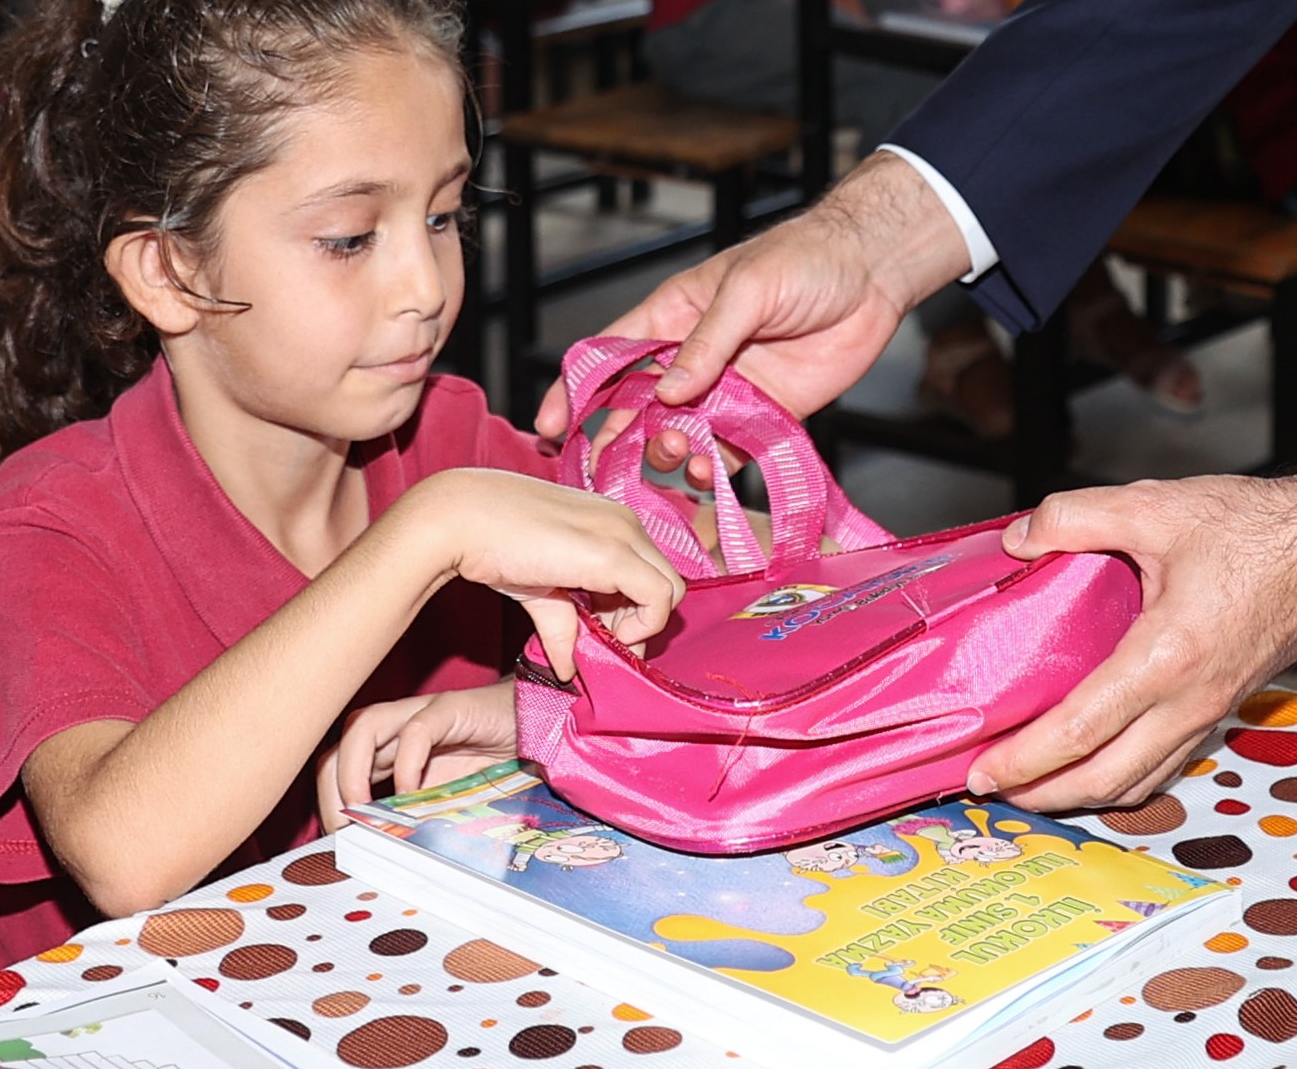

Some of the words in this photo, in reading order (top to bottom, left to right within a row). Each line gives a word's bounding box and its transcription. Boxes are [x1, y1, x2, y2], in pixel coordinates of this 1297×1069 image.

[1013, 852, 1080, 877] İLK
[861, 868, 970, 919] KİTABI
[914, 871, 1026, 922] OKUMA
[1004, 893, 1040, 907] 1.
[816, 919, 933, 968] YAZMA
[940, 903, 1018, 945] SINIF
[951, 896, 1101, 965] İLKOKUL
